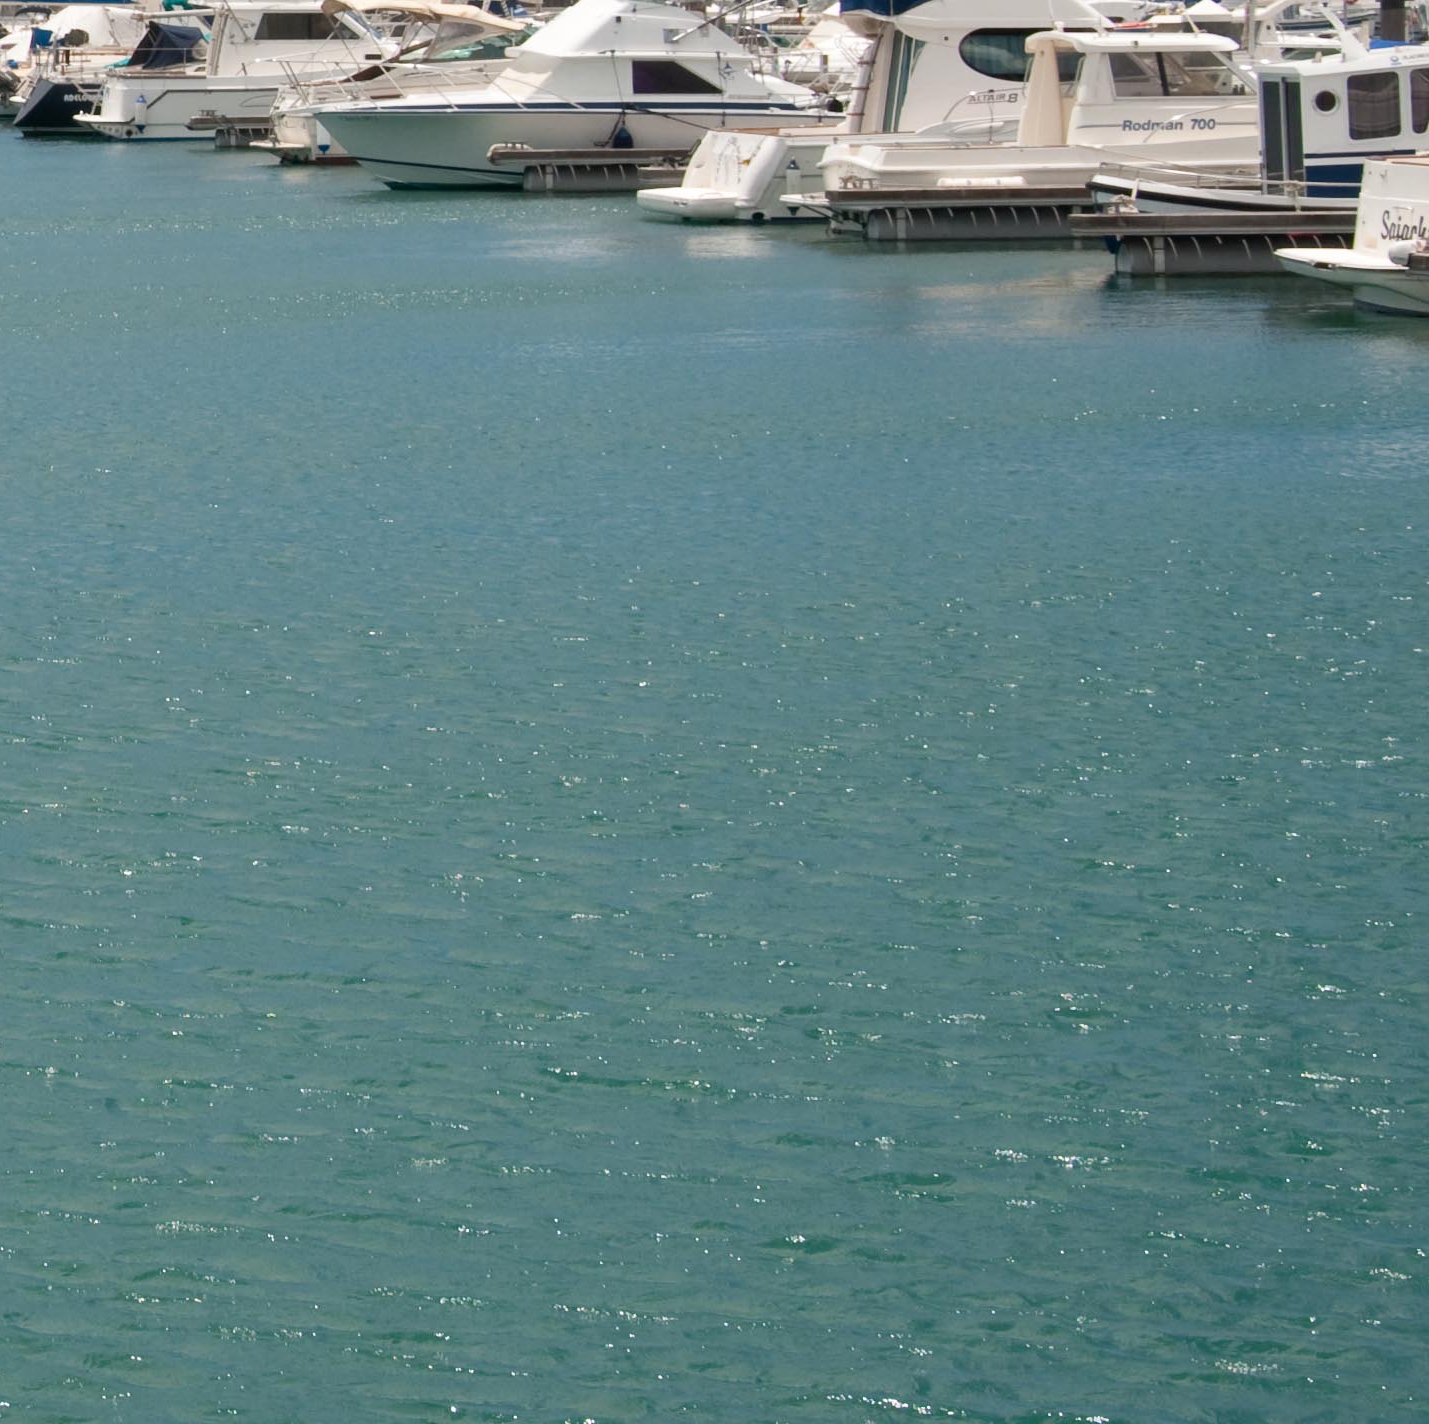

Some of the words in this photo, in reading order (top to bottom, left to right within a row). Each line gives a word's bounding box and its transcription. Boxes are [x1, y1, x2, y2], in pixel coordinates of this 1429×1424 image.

[1008, 92, 1018, 104] 8
[1122, 119, 1184, 132] Rodman
[1190, 118, 1216, 130] 700
